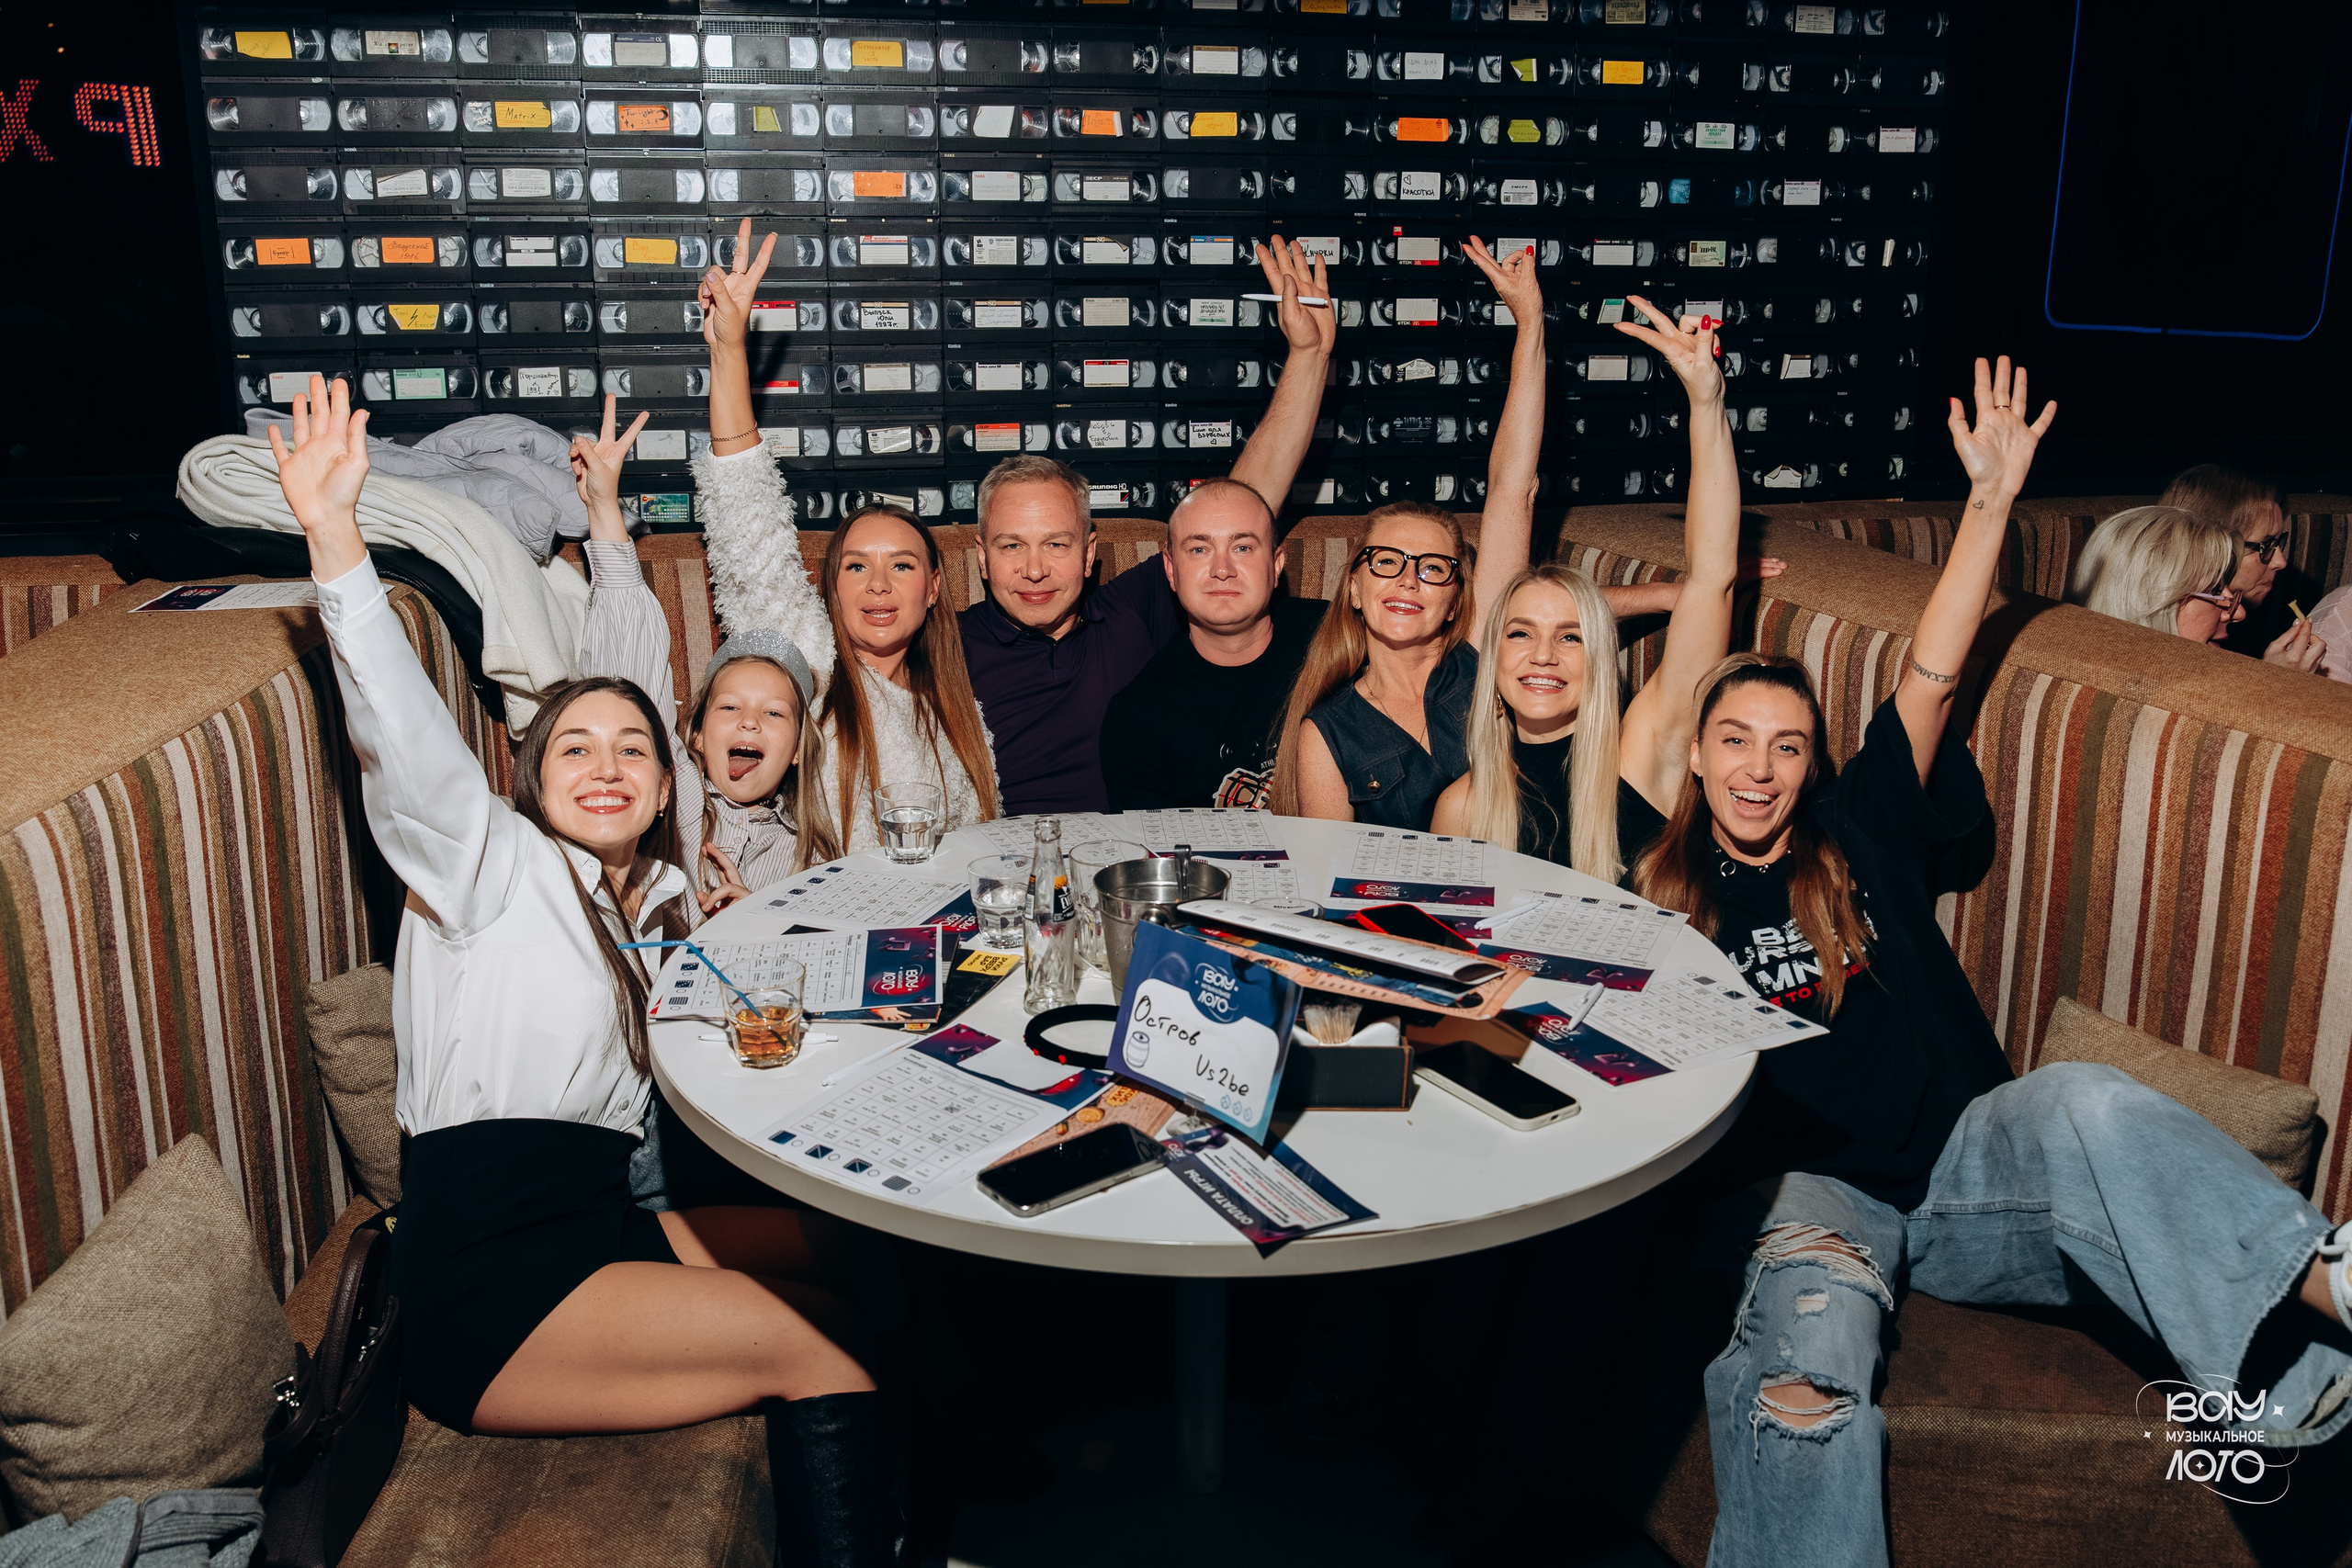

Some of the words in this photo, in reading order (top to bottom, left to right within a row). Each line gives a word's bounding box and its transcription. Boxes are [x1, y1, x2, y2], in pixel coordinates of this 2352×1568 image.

[505, 107, 537, 120] Matrix
[623, 107, 655, 118] Twilight
[1402, 188, 1435, 197] КРАСОТКИ
[863, 308, 892, 316] Выпуск
[1751, 918, 1805, 946] BE
[979, 955, 992, 965] БАР
[1728, 940, 1815, 974] URS
[881, 972, 896, 990] ЛОТО
[1197, 990, 1228, 1013] ЛОТО
[1785, 987, 1812, 1002] TO
[1134, 995, 1202, 1046] Остров
[1183, 1168, 1214, 1194] ИГРЫ
[1213, 1191, 1254, 1225] ОПЛАТА
